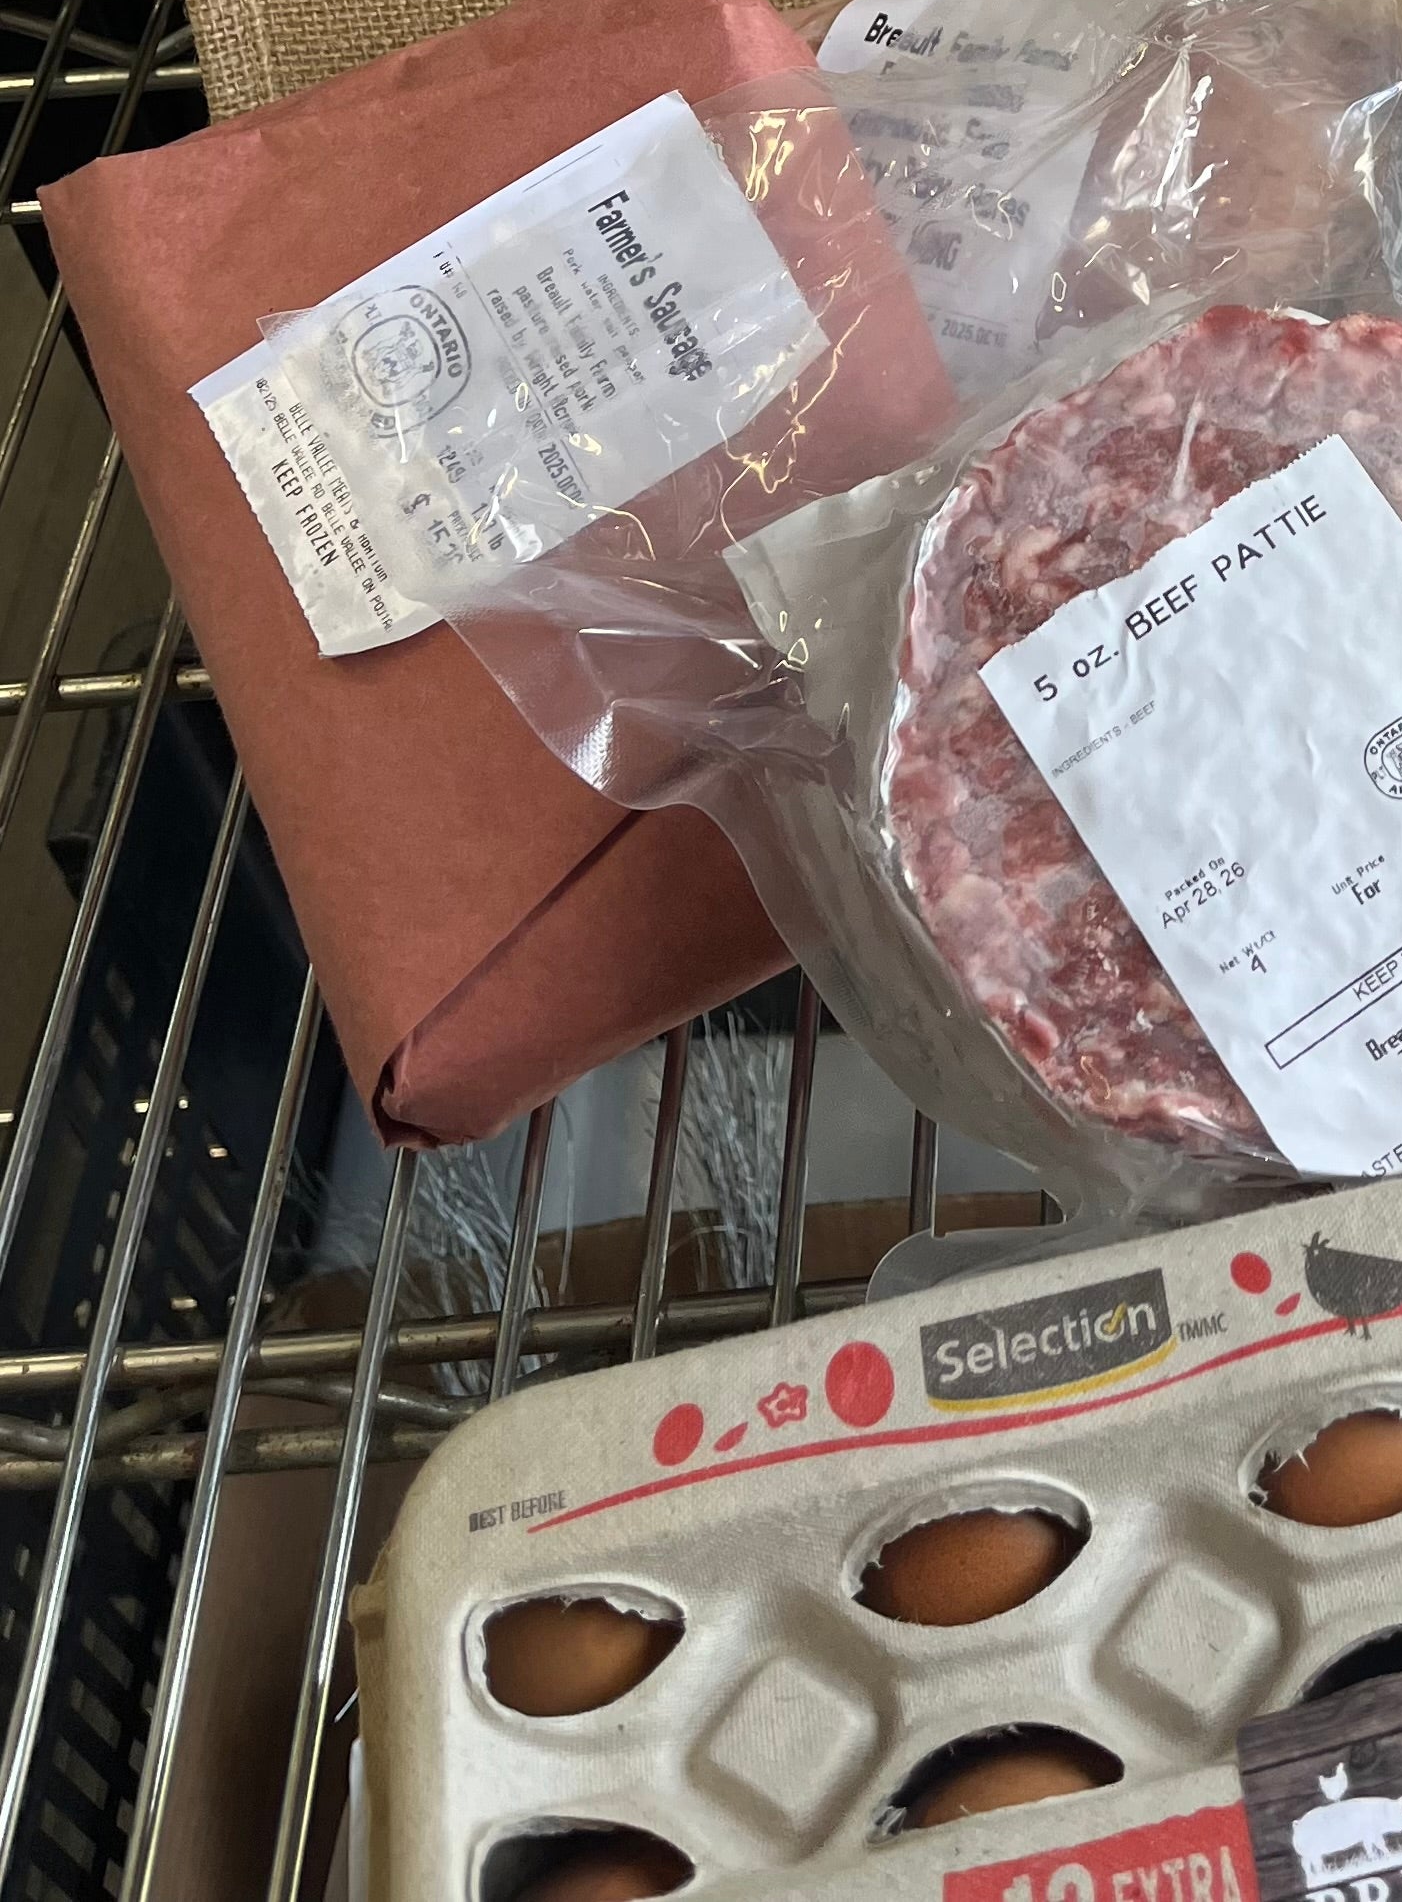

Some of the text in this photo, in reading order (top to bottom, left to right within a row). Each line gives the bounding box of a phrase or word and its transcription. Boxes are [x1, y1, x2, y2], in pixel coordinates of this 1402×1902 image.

[587, 189, 655, 286] Farmer's
[535, 265, 573, 315] Breault
[410, 288, 472, 378] ONTARIO
[288, 402, 314, 436] BELLE
[307, 434, 337, 476] VALLEE
[271, 458, 340, 566] KEEP FROZEN
[273, 412, 296, 444] BELLE
[291, 444, 316, 482] VALLEE
[321, 502, 345, 535] BELLE
[361, 577, 376, 594] ON
[1033, 494, 1326, 701] 5 oz. BEEF PATTIE
[1051, 725, 1122, 778] INGREDIENTS
[1129, 700, 1154, 725] BEEF
[1162, 900, 1190, 929] Apr
[1220, 861, 1245, 887] 26
[1164, 857, 1225, 901] Packed On
[1351, 879, 1381, 905] For
[1356, 855, 1385, 877] Price
[1219, 956, 1240, 973] Net
[1348, 959, 1398, 1001] KEEP
[936, 1301, 1158, 1384] Selection
[469, 1489, 568, 1533] BEST BEFORE
